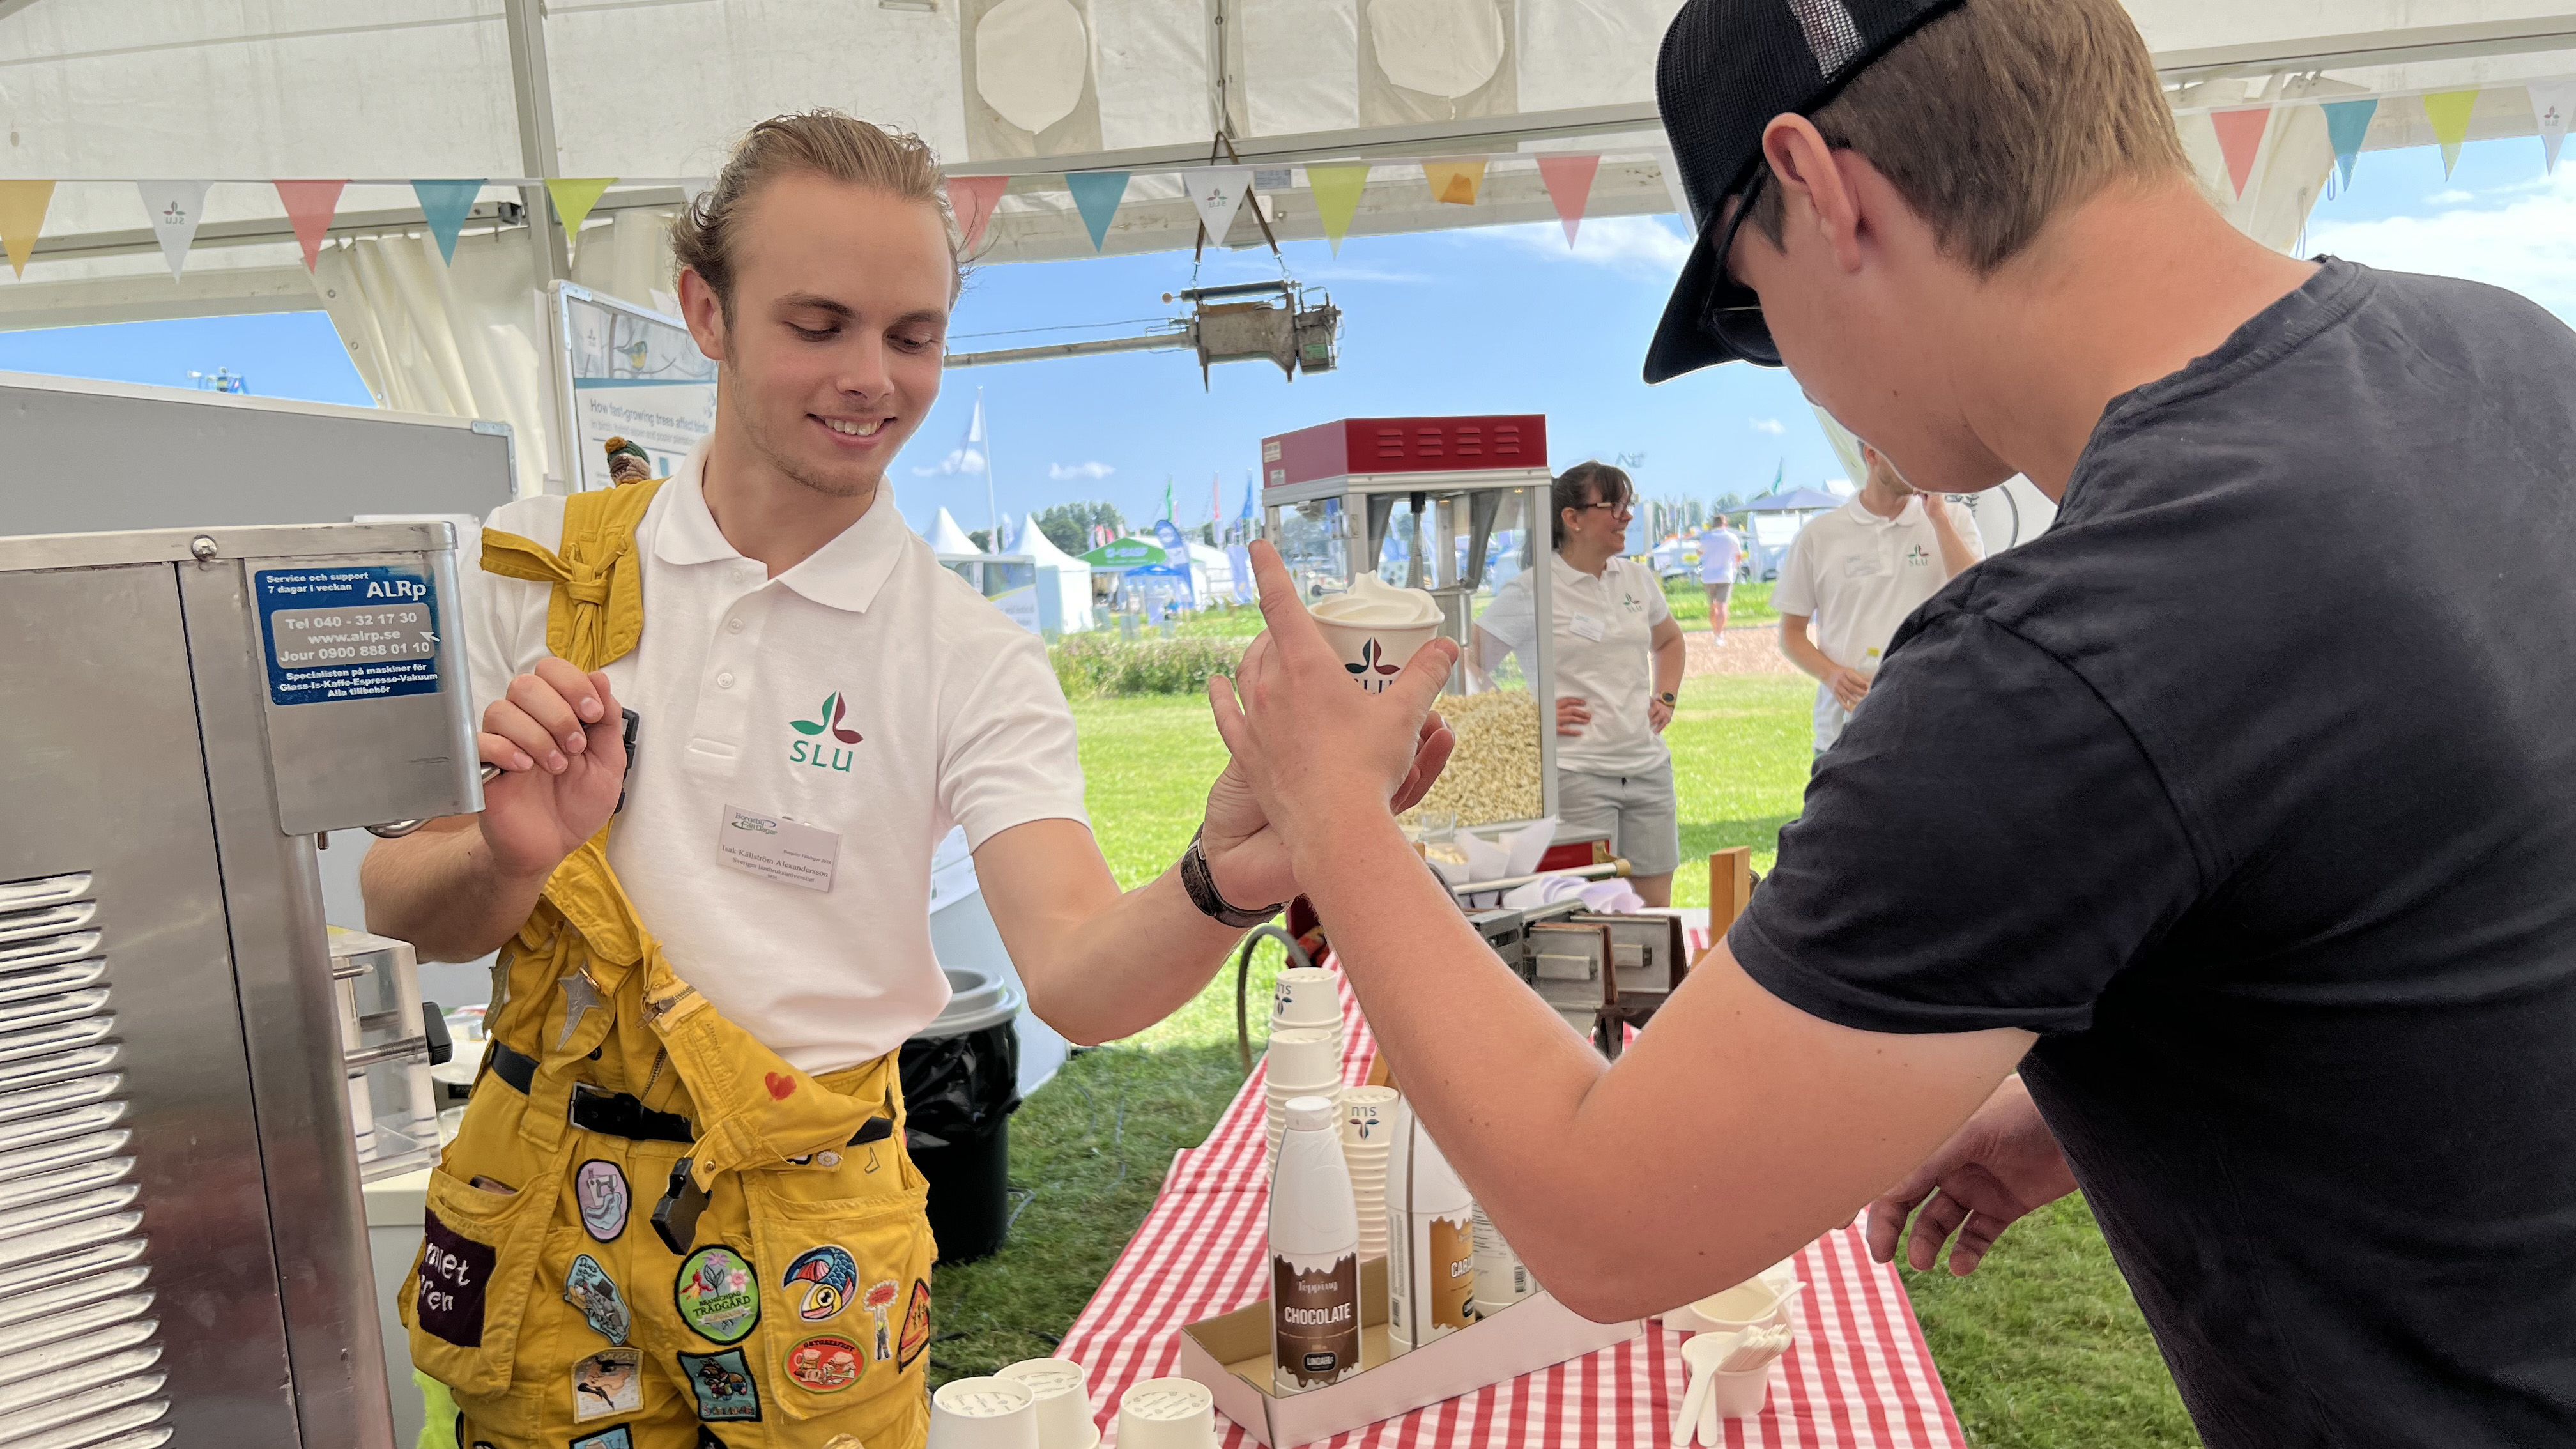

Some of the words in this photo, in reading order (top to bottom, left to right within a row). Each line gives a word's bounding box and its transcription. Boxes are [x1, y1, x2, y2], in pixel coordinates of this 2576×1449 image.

[590, 398, 608, 414] How
[656, 413, 675, 427] trees
[266, 575, 307, 584] Service
[309, 574, 328, 582] och
[330, 572, 369, 581] support
[277, 585, 307, 594] dagar
[314, 583, 352, 592] veckan
[367, 579, 427, 601] ALRp
[286, 618, 309, 629] Tel
[314, 617, 342, 628] 040
[356, 615, 374, 626] 32
[378, 613, 394, 624] 17
[399, 612, 417, 623] 30
[307, 629, 401, 645] www.alrp.se
[280, 650, 315, 662] Jour
[319, 646, 355, 659] 0900
[360, 645, 387, 657] 888
[390, 643, 408, 654] 01
[415, 641, 430, 653] 10
[286, 669, 349, 681] Specialisten
[351, 667, 364, 677] på
[367, 665, 411, 675] maskiner
[413, 663, 427, 671] för
[279, 673, 438, 692] Glass-Is-Kaffe-Espresso-Vakuum
[328, 689, 348, 698] Alla
[349, 686, 390, 696] tillbehör
[790, 740, 854, 773] SLU
[735, 812, 765, 827] Borgeby
[722, 844, 737, 854] Isak
[739, 849, 774, 865] Källström
[775, 860, 829, 878] Alexandersson
[733, 857, 757, 870] Sveriges
[1351, 1106, 1377, 1117] SLU
[1296, 1280, 1338, 1294] Topping
[1284, 1302, 1352, 1325] CHOCOLATE
